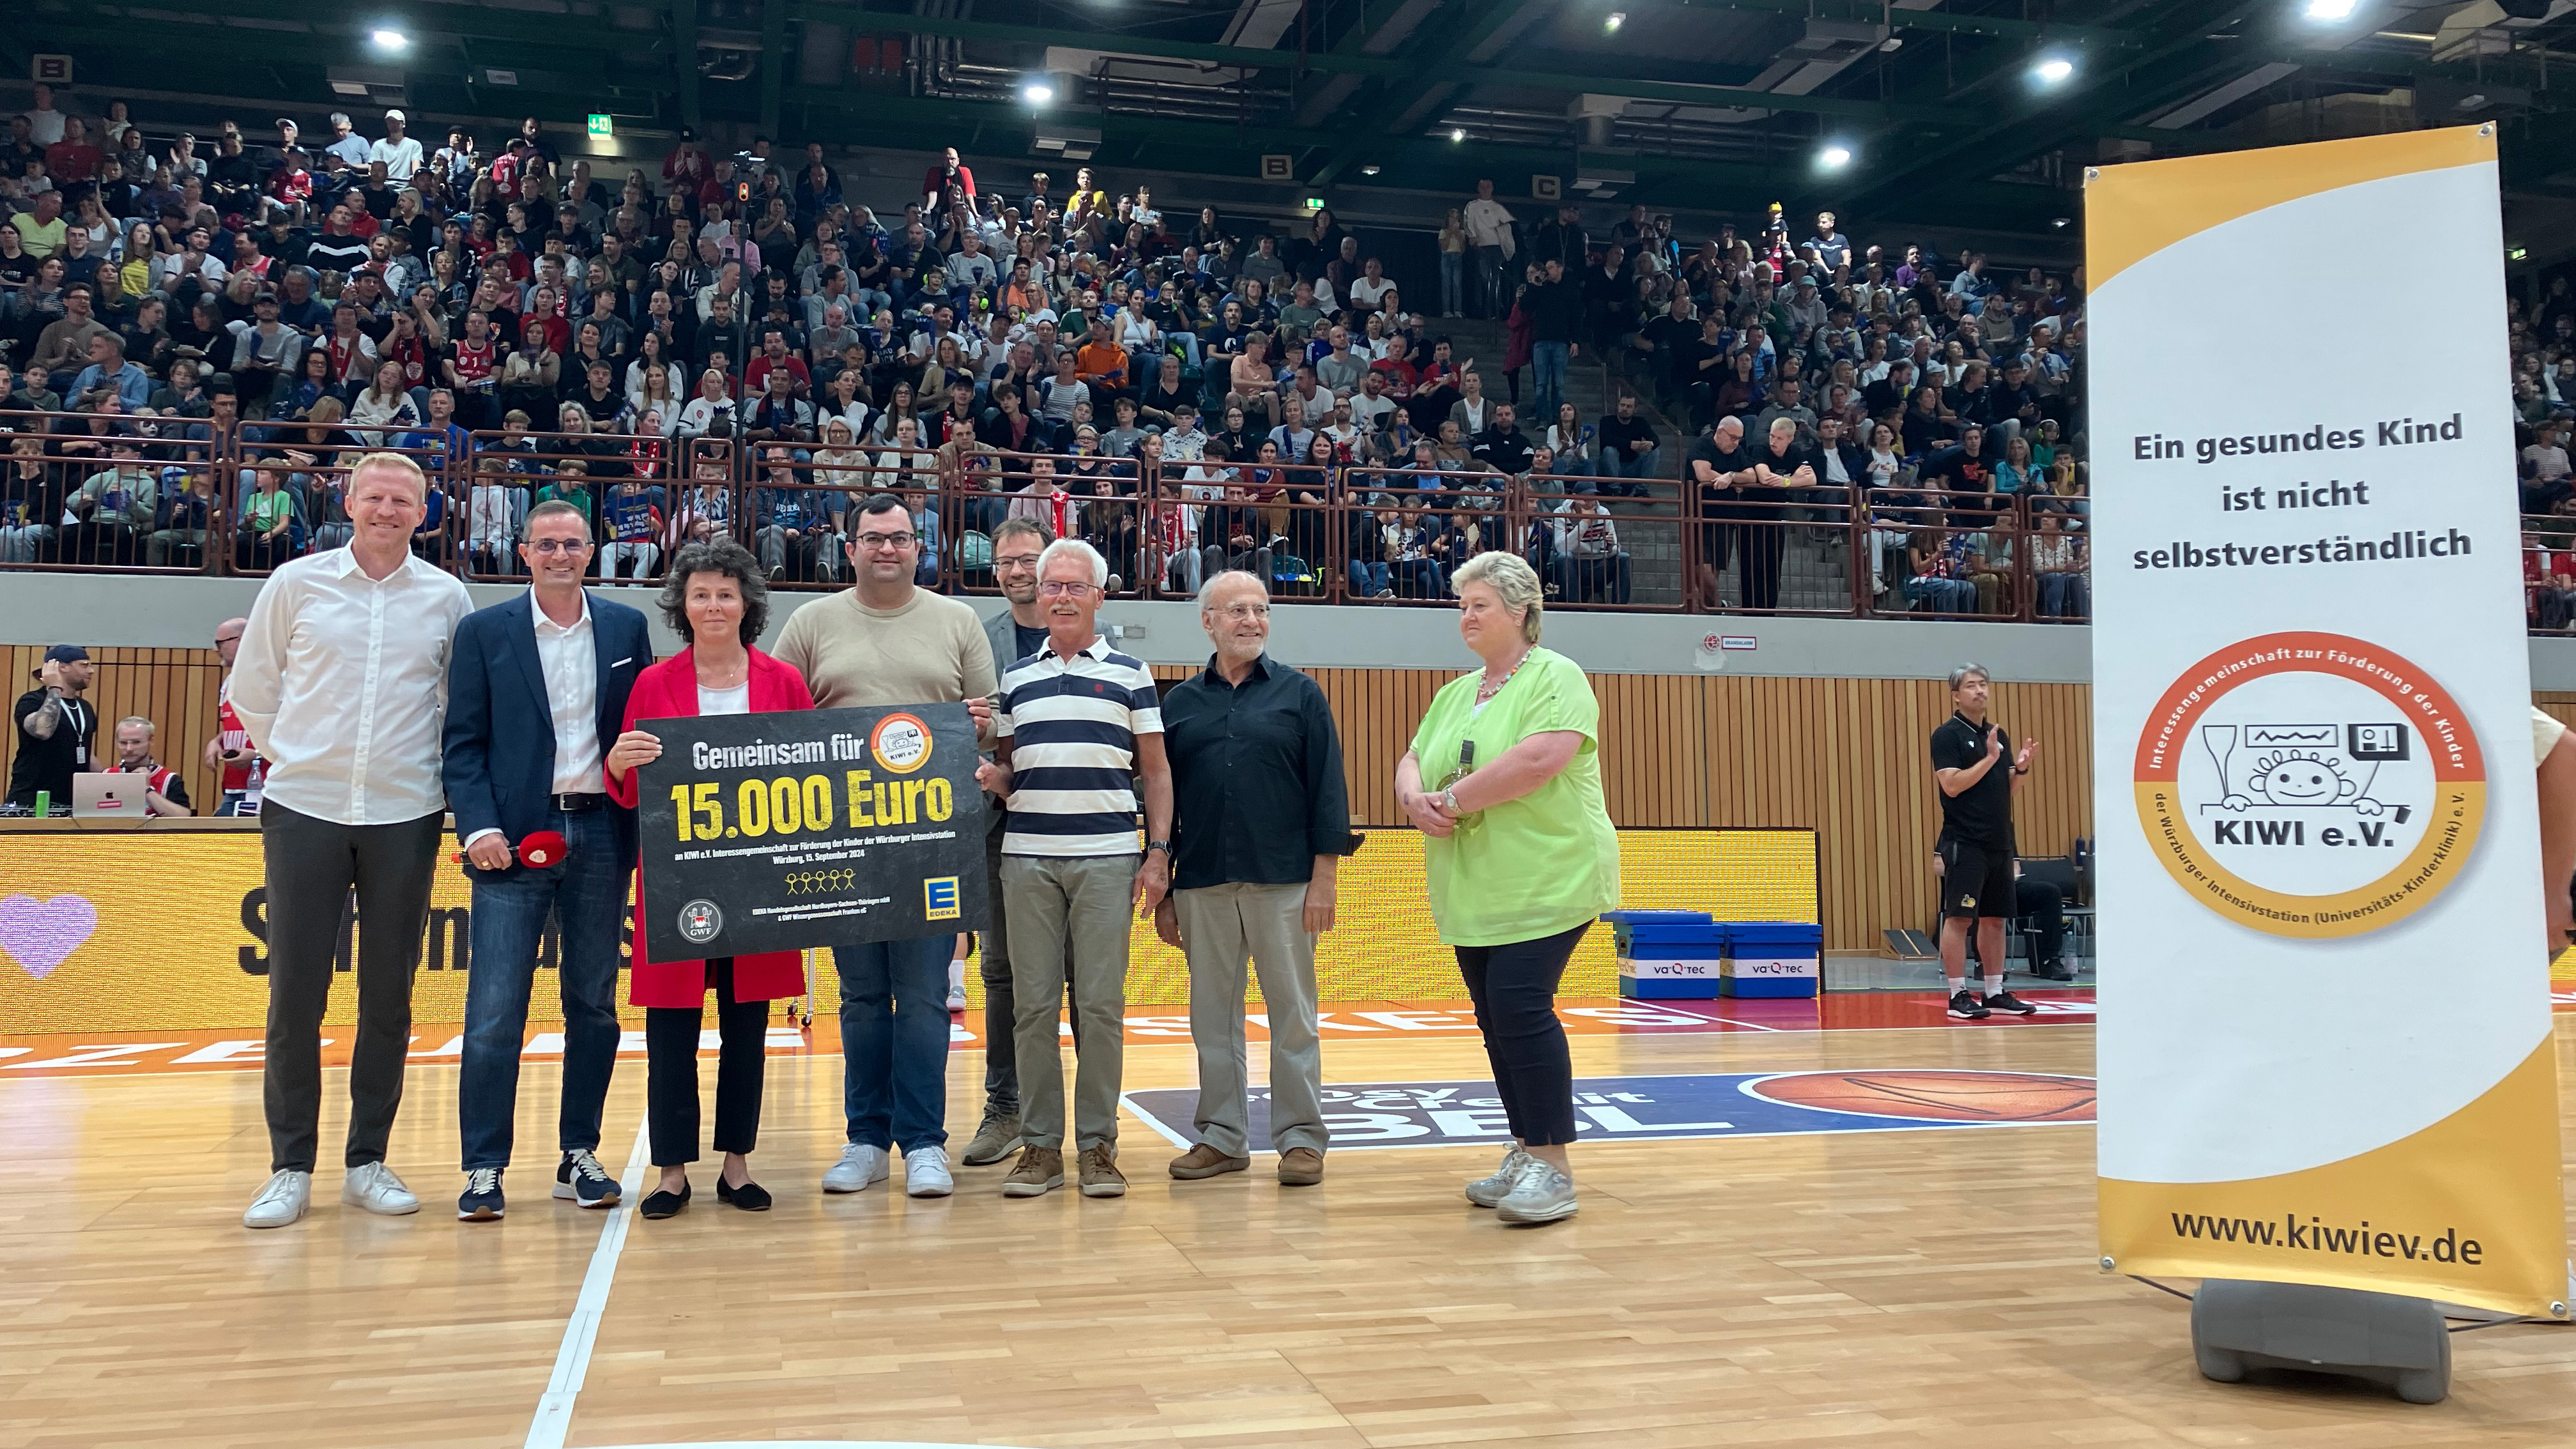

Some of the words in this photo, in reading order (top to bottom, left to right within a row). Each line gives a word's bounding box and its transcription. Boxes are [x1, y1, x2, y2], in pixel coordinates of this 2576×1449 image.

[40, 59, 65, 77] B
[1267, 158, 1288, 175] B
[1538, 179, 1556, 195] C
[2135, 434, 2184, 460] Ein
[2196, 424, 2365, 464] gesundes
[2377, 413, 2463, 446] Kind
[2223, 486, 2266, 511] ist
[2278, 480, 2370, 509] nicht
[2134, 528, 2472, 569] selbstverständlich
[2149, 648, 2292, 769] Interessengemeinschaft
[2296, 649, 2323, 659] zur
[2327, 649, 2414, 695] Förderung
[2414, 692, 2439, 717] der
[2434, 717, 2465, 769] Kinder
[692, 738, 827, 771] Gemeinsam
[830, 733, 864, 762] für
[890, 751, 907, 760] KIWI
[670, 774, 834, 842] 15.000
[846, 769, 953, 829] Euro
[2155, 792, 2167, 814] der
[2452, 792, 2465, 804] V.
[2453, 806, 2464, 818] e.
[674, 853, 684, 861] an
[684, 850, 700, 861] KIWI
[700, 850, 712, 859] e.V.
[712, 844, 788, 858] Interessengemeinschaft
[789, 843, 799, 852] zur
[800, 839, 831, 850] Förderung
[832, 839, 843, 848] der
[843, 837, 863, 847] Kinder
[864, 836, 875, 846] der
[875, 833, 911, 844] Würzburger
[911, 829, 956, 841] Intensivstation
[2214, 820, 2305, 846] KIWI
[2321, 821, 2395, 847] e.V.
[772, 854, 805, 865] Würzburg,
[805, 853, 815, 862] 15.
[815, 850, 848, 863] September
[848, 848, 866, 859] 2024
[2160, 815, 2208, 882] Würzburger
[2314, 820, 2464, 926] (Universitäts-Kinderklinik)
[928, 881, 955, 909] E
[2206, 879, 2310, 924] Intensivstation
[752, 907, 767, 916] EDEKA
[767, 903, 811, 914] Handelsgesellschaft
[930, 909, 957, 917] EDEKA
[690, 927, 712, 936] GWF
[2171, 1212, 2483, 1266] www.kiwiev.de
